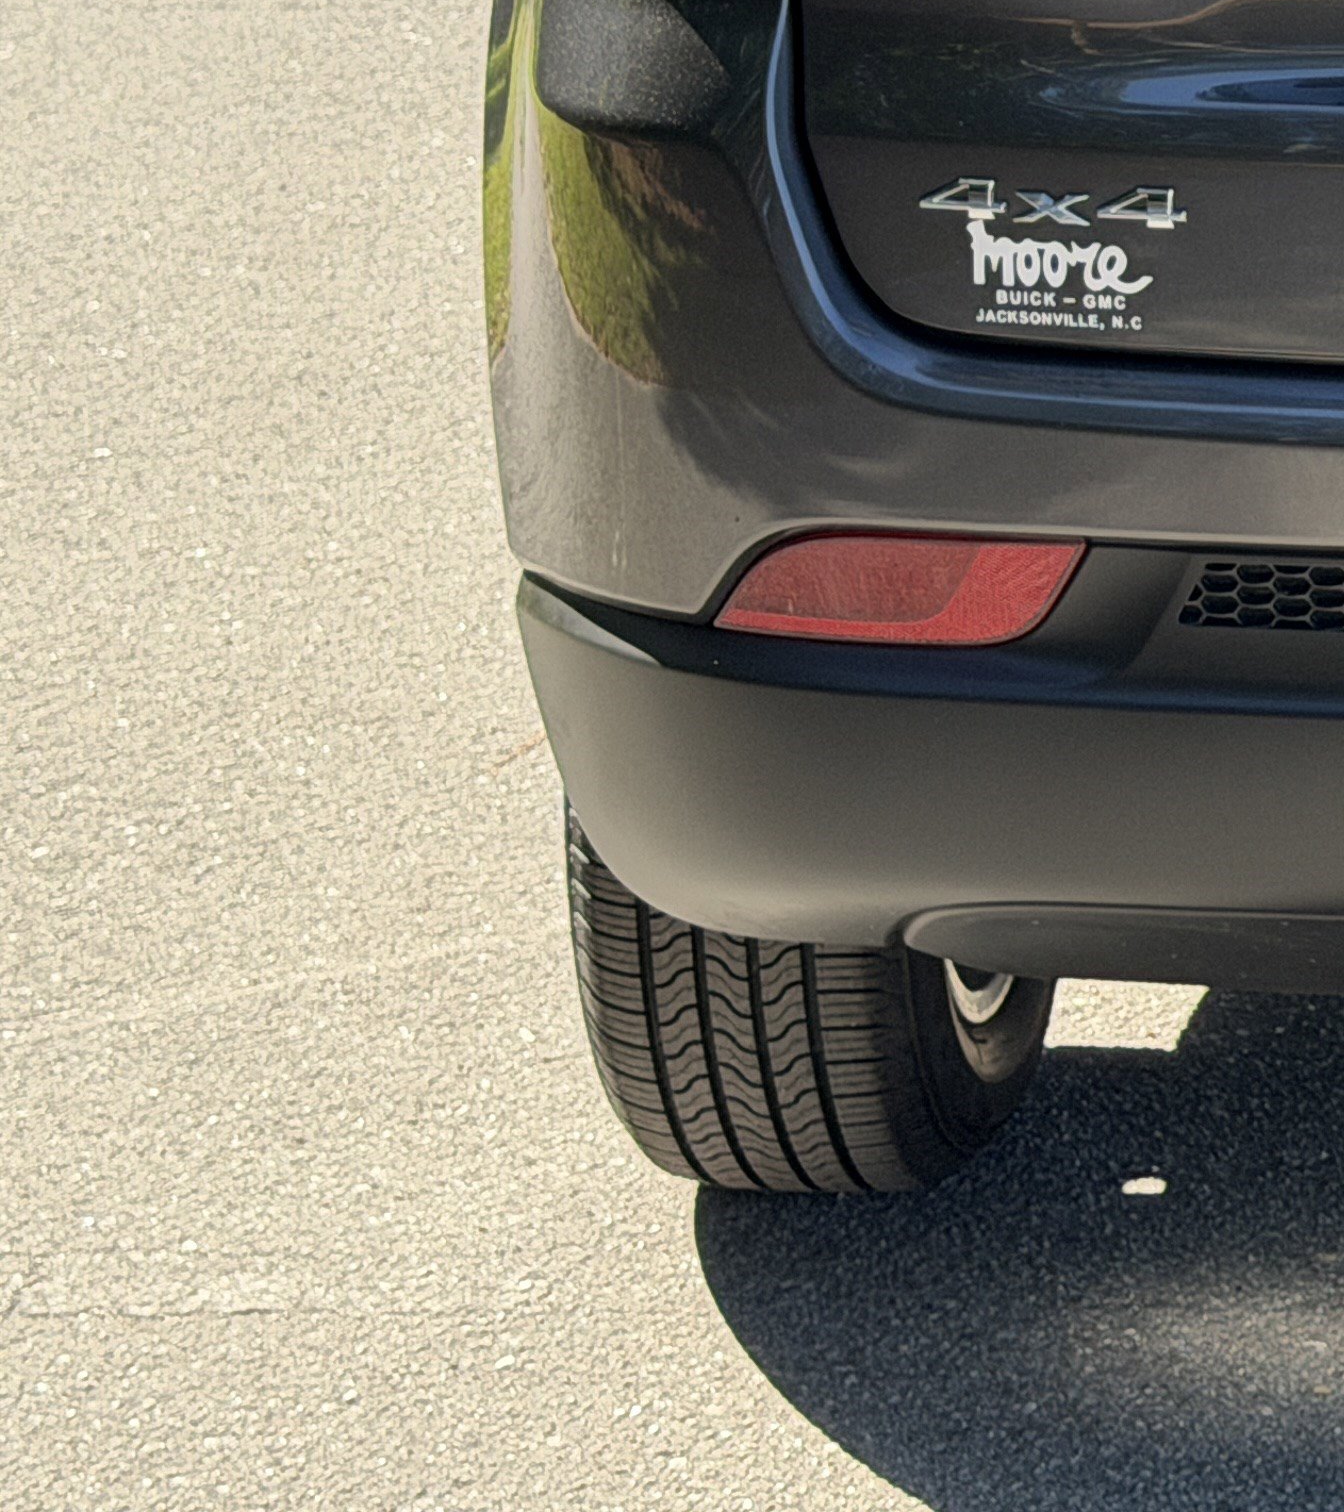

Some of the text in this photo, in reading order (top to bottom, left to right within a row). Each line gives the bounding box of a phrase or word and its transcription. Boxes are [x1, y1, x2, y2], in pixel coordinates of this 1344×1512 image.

[995, 288, 1056, 307] BUICK
[1082, 293, 1126, 310] GMC
[975, 308, 1105, 331] JACKSONVILLE,
